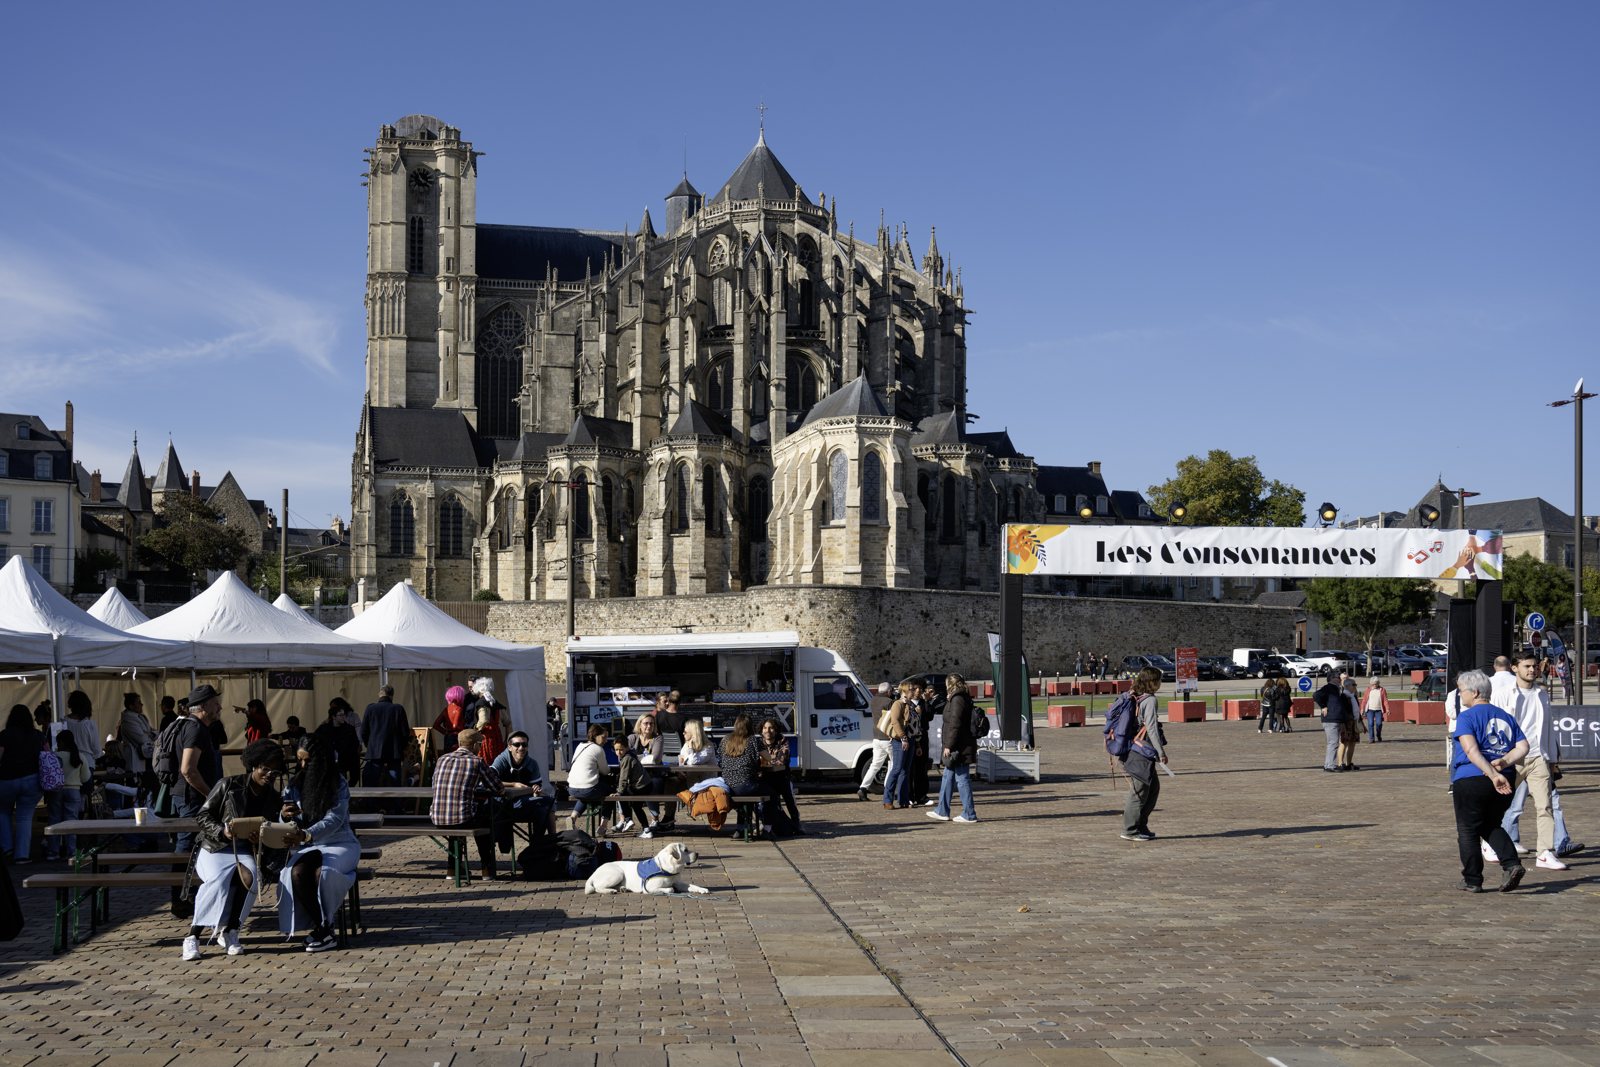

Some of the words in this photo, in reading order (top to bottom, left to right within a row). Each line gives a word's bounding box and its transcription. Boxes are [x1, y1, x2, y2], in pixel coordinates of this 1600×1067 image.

[1096, 540, 1152, 563] Les
[1161, 541, 1377, 566] Consonances
[1559, 731, 1585, 747] LE
